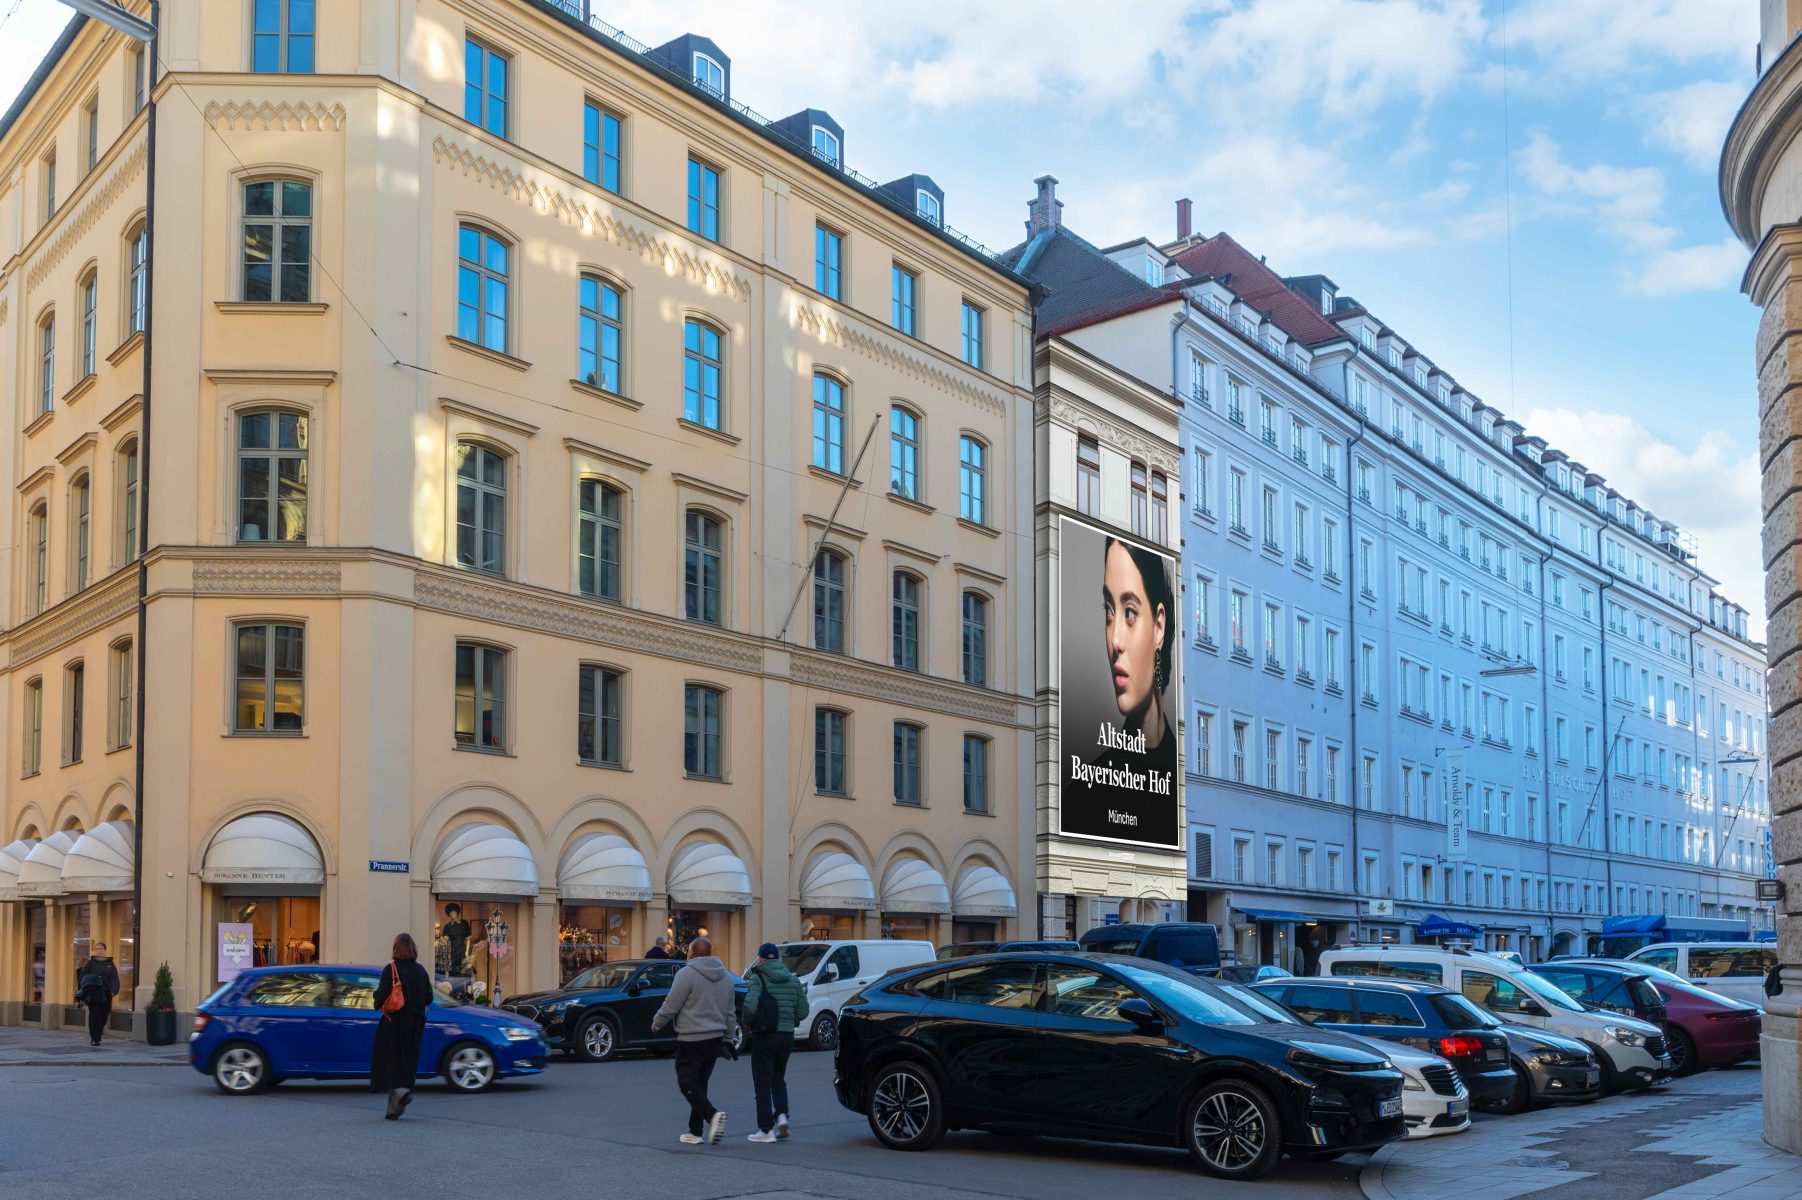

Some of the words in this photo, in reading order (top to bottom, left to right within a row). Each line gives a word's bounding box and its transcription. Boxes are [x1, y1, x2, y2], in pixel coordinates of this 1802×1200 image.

[1097, 722, 1147, 754] Altstadt
[1071, 755, 1146, 791] Bayerischer
[1148, 769, 1171, 795] Hof
[1451, 766, 1463, 806] Arnoldy
[1108, 809, 1138, 826] München
[1453, 809, 1463, 819] &
[1453, 822, 1463, 847] Team
[373, 861, 407, 871] Prannerstr.
